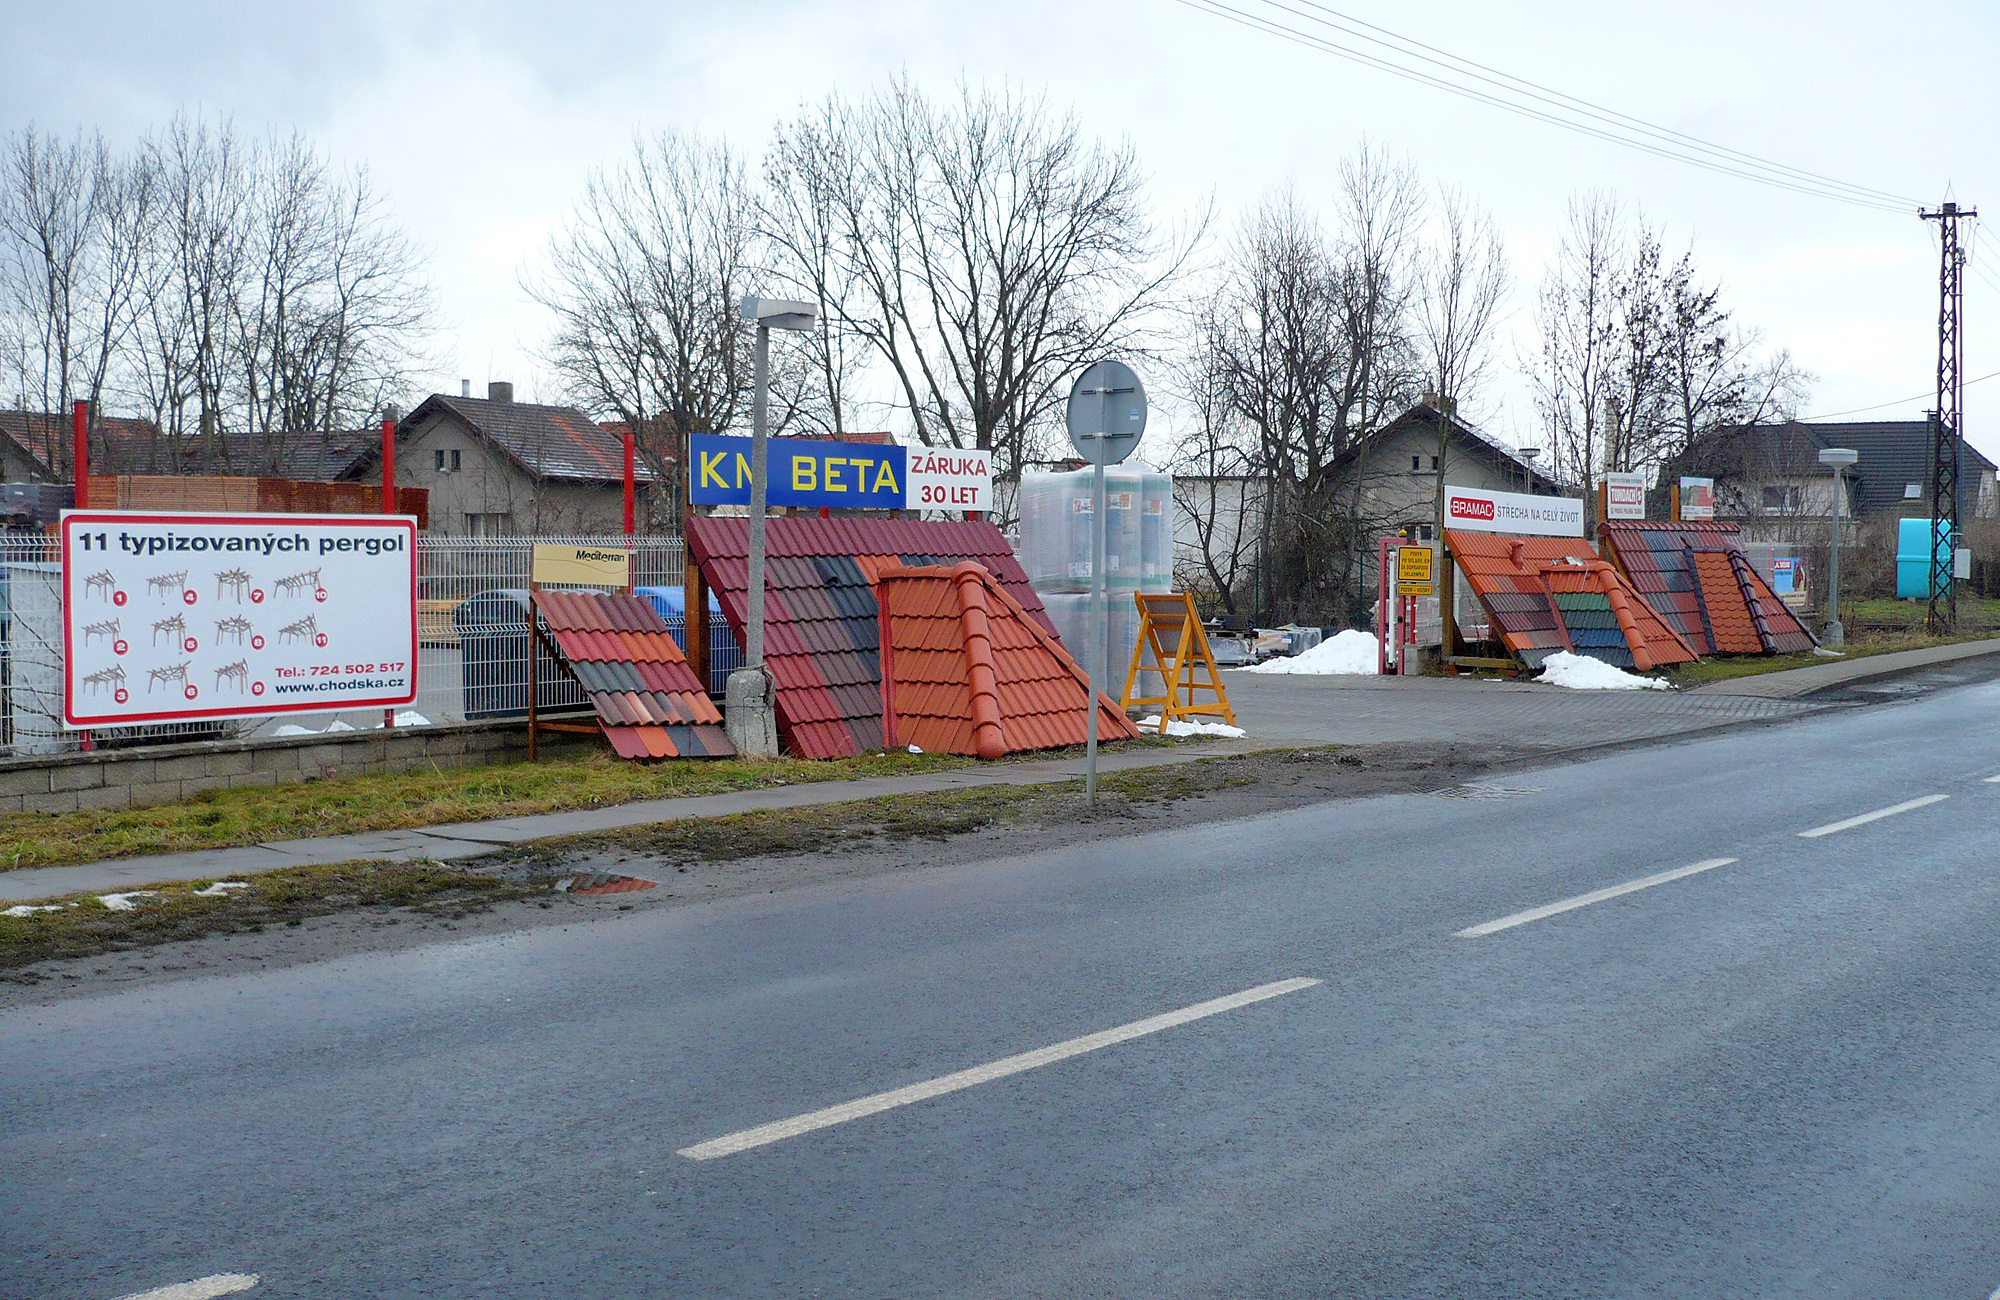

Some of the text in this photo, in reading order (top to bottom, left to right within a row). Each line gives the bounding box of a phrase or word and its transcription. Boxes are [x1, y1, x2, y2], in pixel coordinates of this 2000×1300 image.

[911, 451, 988, 477] ZÁRUKA
[792, 455, 899, 494] BETA
[921, 486, 979, 504] 30 LET
[1611, 487, 1636, 503] TONDACH
[1452, 500, 1579, 523] BRAMAC STŘECHA NA CELÝ ŽIVOT
[79, 532, 404, 556] 11 typizovaných pergol
[276, 662, 405, 677] Tel.: 724 502 517
[275, 678, 405, 694] www.chodska.cz
